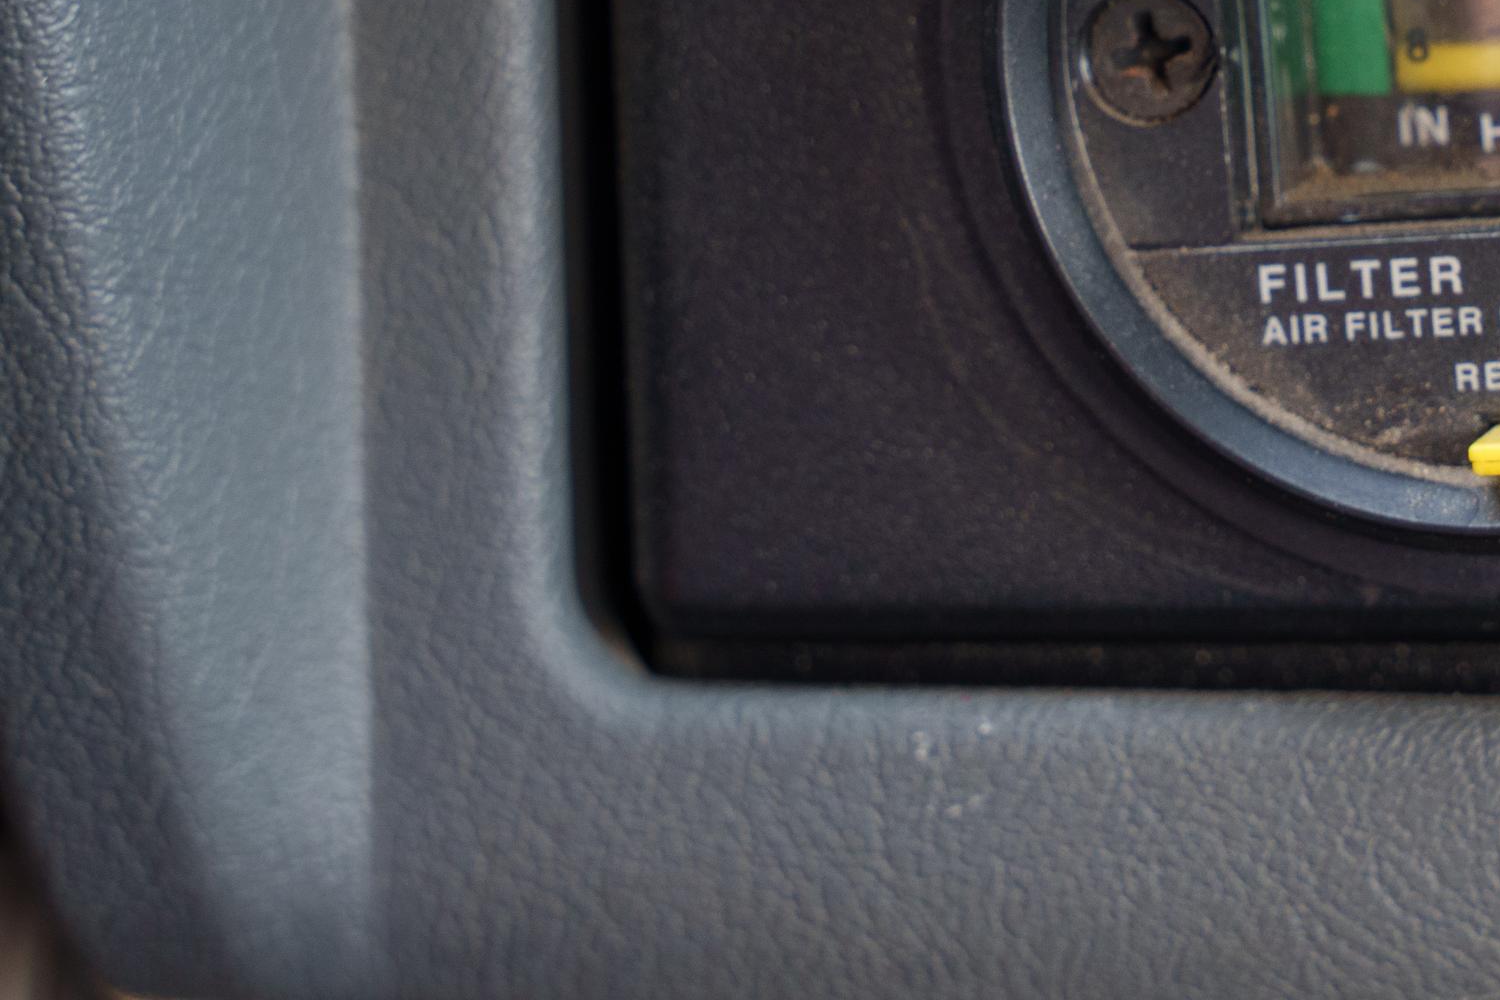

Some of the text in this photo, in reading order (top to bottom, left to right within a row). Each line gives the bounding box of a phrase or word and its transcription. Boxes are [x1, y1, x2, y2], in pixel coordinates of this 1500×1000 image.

[1399, 103, 1449, 148] IN
[1257, 254, 1464, 304] FILTER
[1261, 312, 1329, 346] AIR
[1344, 305, 1483, 342] FILTER
